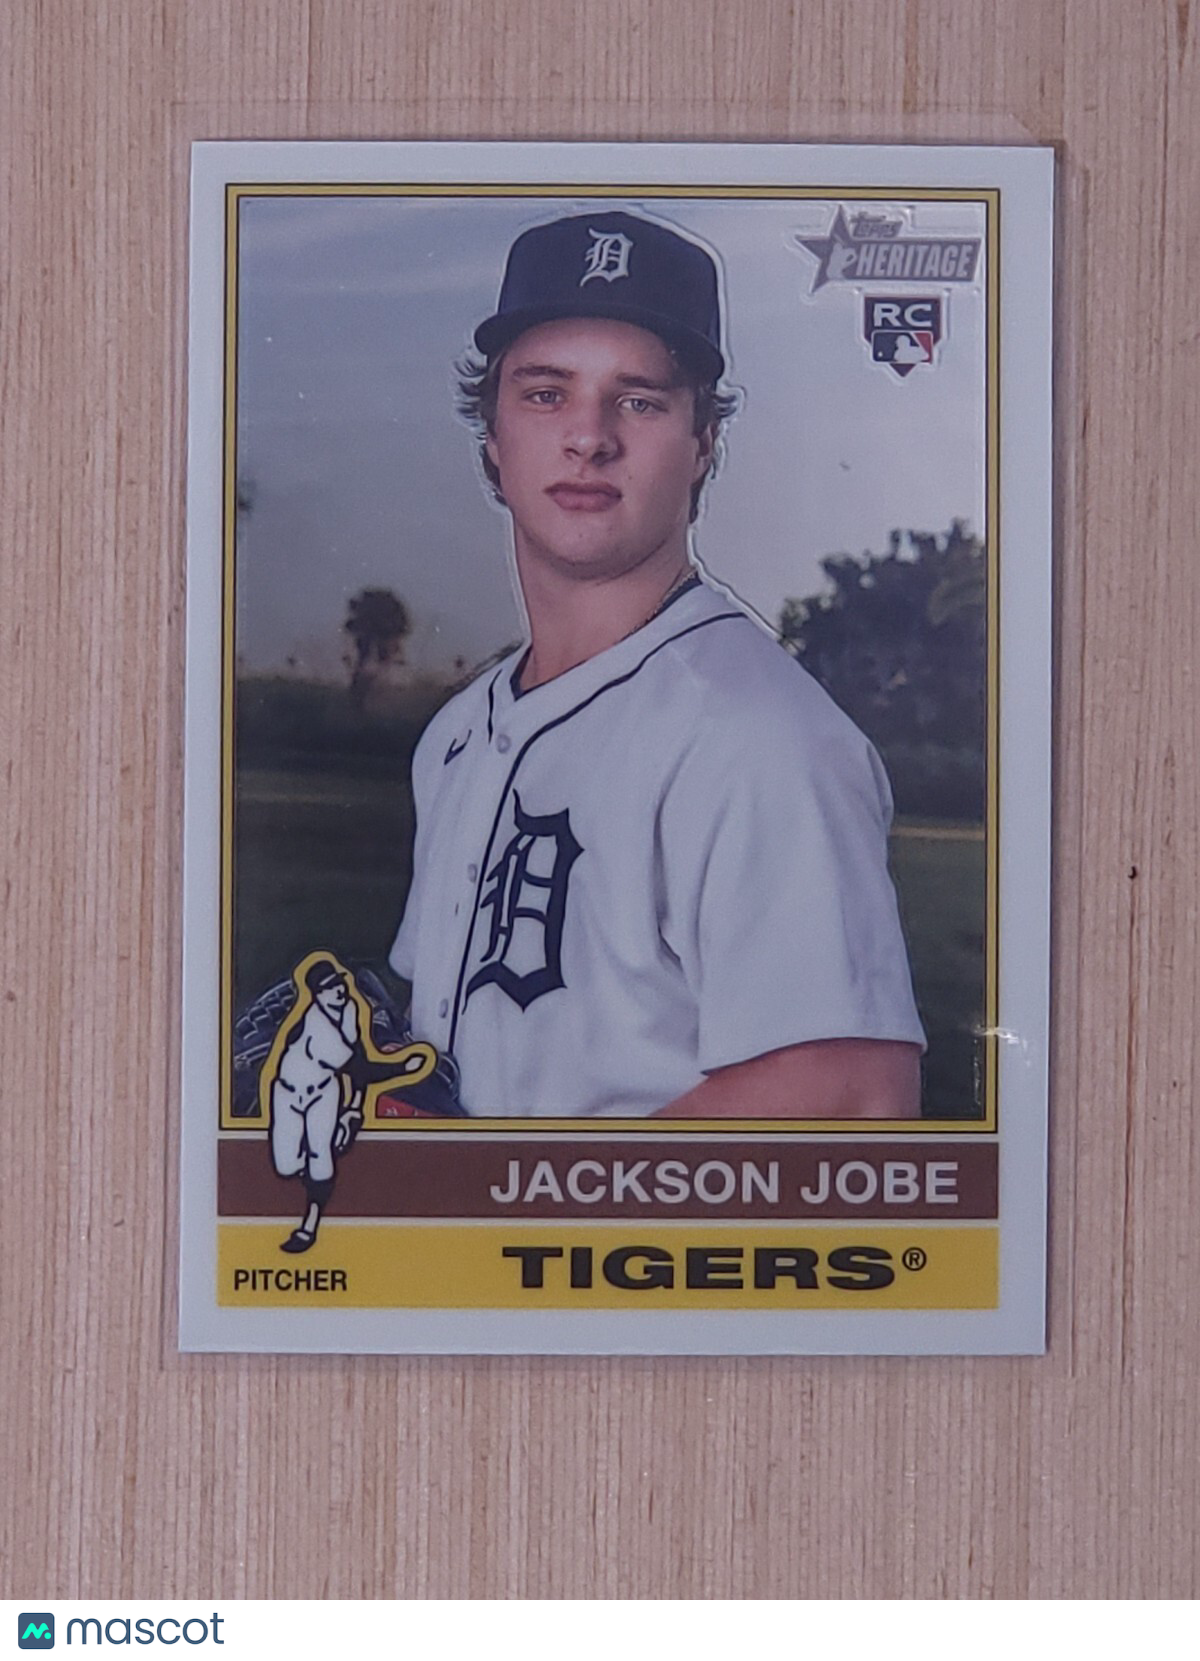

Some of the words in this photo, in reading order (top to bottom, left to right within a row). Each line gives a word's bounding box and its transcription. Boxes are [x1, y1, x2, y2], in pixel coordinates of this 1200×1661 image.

[580, 227, 634, 287] D
[855, 244, 971, 278] HERITAGE
[873, 303, 932, 327] RC
[461, 787, 585, 1013] D
[490, 1160, 780, 1204] JACKSON
[801, 1162, 960, 1204] JOBE
[233, 1269, 347, 1291] PITCHER
